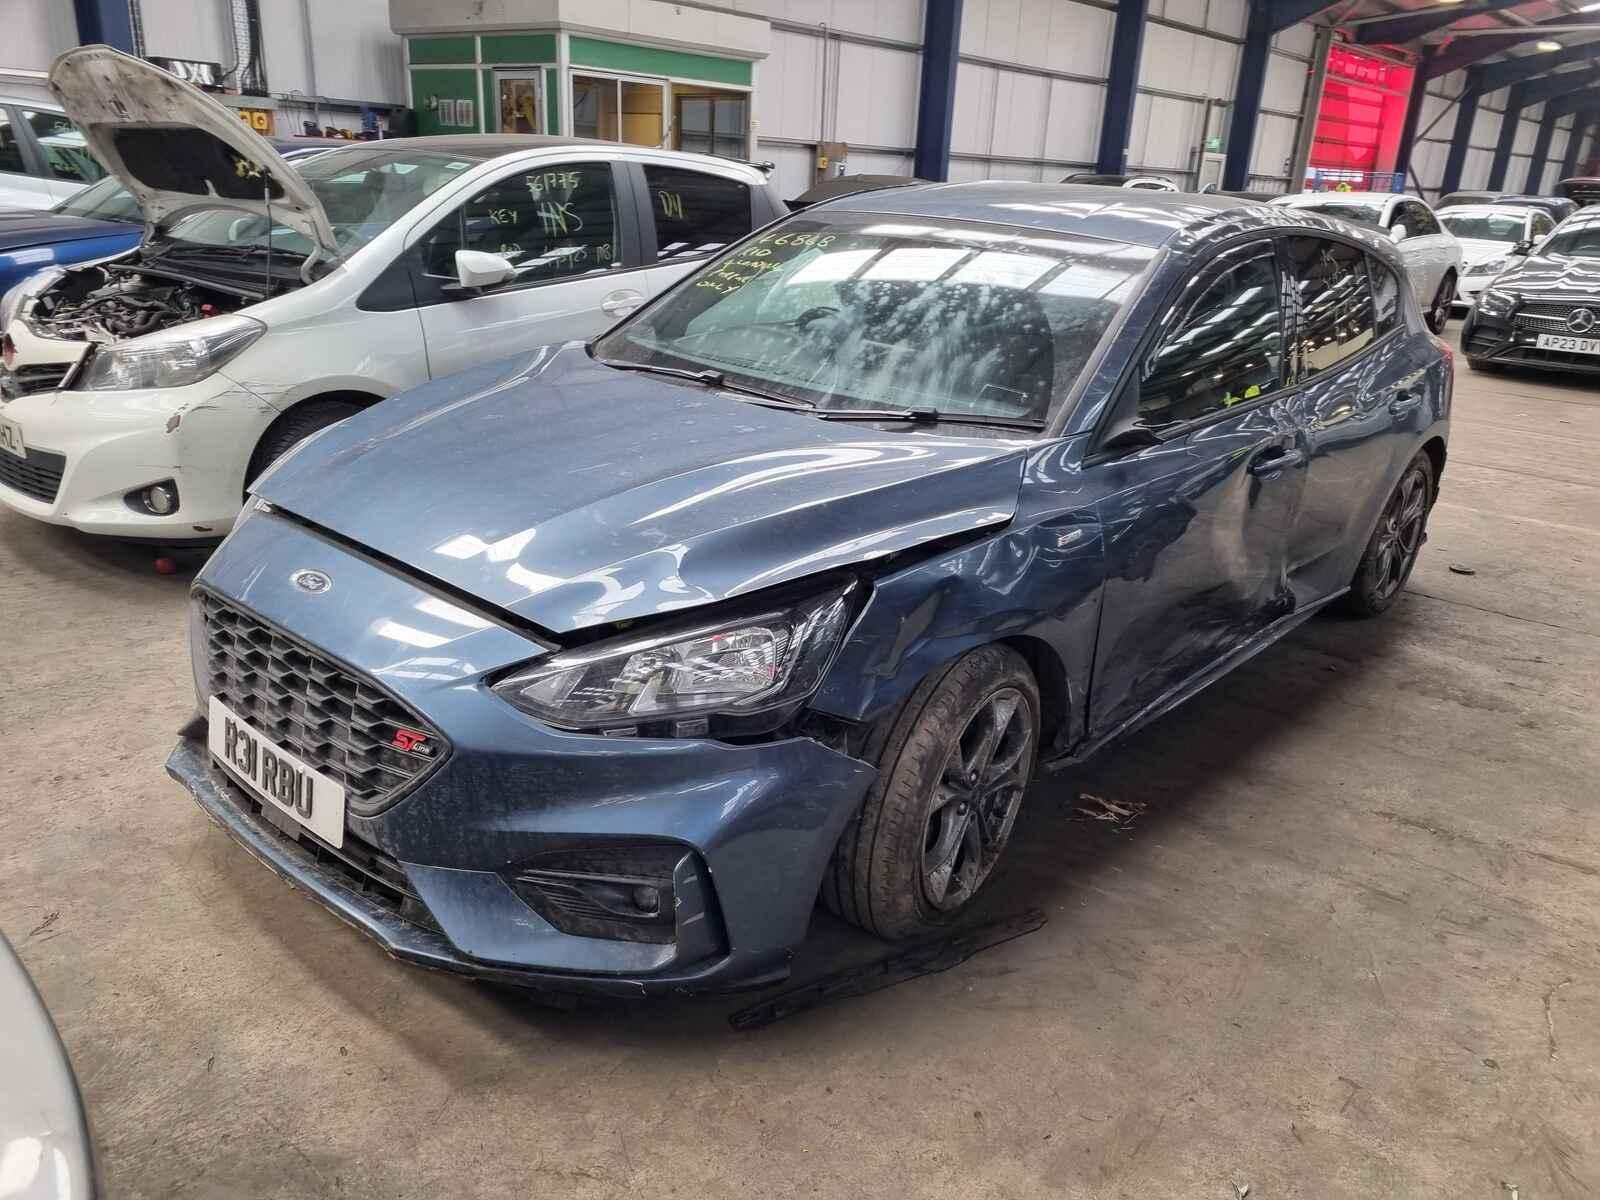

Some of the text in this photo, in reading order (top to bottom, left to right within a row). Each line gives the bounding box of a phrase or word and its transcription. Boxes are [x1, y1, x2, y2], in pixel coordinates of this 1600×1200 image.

[487, 207, 519, 225] KEY
[1543, 336, 1600, 352] AP23 DV
[392, 729, 426, 752] ST
[224, 716, 314, 820] R31 RBU
